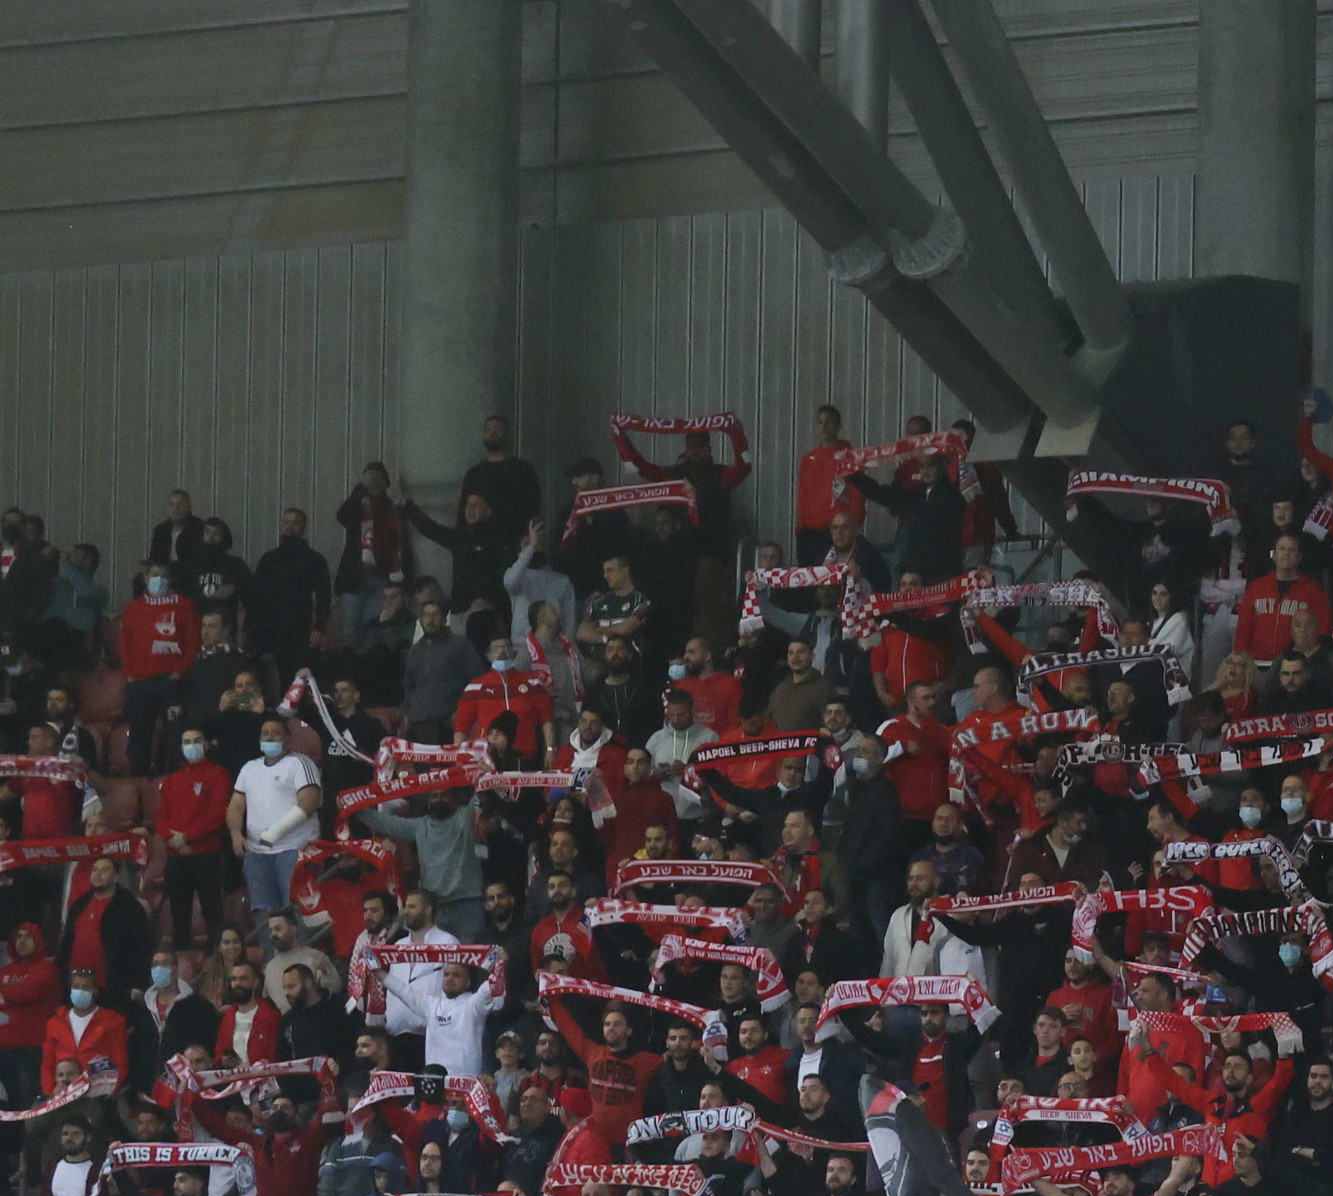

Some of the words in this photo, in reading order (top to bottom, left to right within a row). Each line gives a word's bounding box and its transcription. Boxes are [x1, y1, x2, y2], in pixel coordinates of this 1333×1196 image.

[990, 725, 1011, 741] A
[1021, 712, 1099, 736] ROW
[698, 744, 737, 760] HAPOEL
[739, 738, 803, 753] BEER-SHEVA
[805, 736, 819, 747] FC
[640, 867, 671, 881] שבע
[673, 865, 705, 878] באר
[712, 863, 752, 880] הפועל
[685, 1106, 754, 1135] TOUR
[1039, 1110, 1062, 1121] BEER
[1065, 1110, 1093, 1121] SHEVA
[1087, 1141, 1118, 1162] באר
[1130, 1130, 1176, 1158] הפועל
[115, 1147, 152, 1163] THIS
[156, 1147, 174, 1162] IS
[1041, 1151, 1075, 1168] שבע
